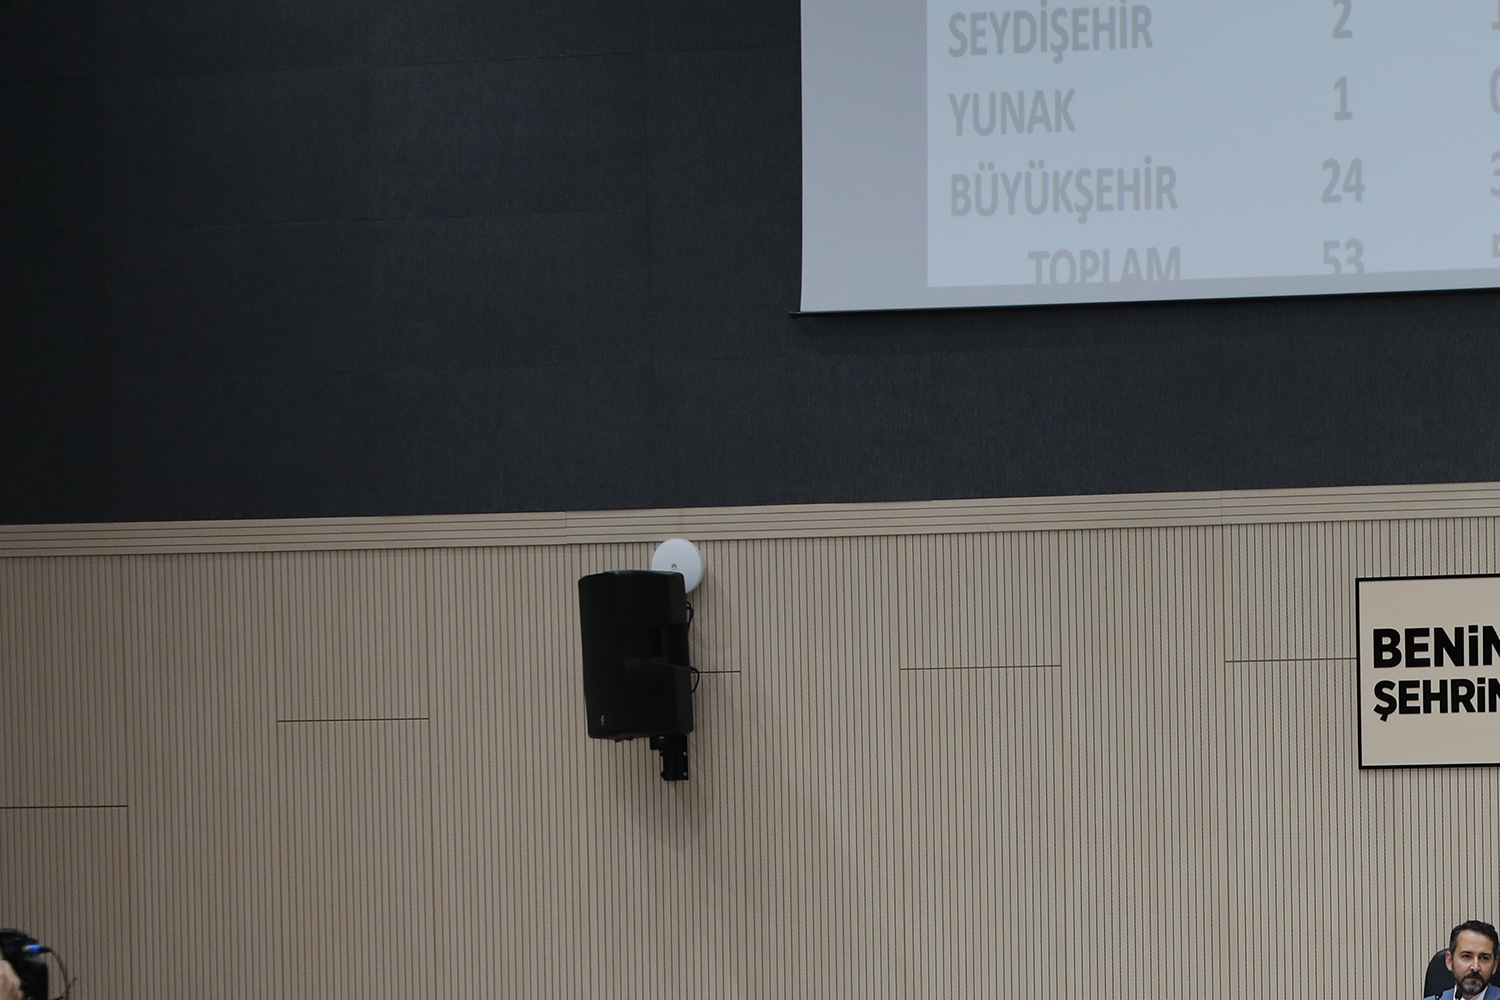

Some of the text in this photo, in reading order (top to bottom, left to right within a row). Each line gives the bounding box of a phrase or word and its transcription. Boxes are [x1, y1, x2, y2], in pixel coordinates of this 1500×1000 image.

[948, 0, 1154, 64] SEYDİŞEHİR
[1332, 0, 1354, 40] 2
[948, 87, 1077, 137] YUNAK
[1333, 76, 1354, 121] 1
[951, 154, 1179, 224] BÜYÜKŞEHİR
[1321, 157, 1366, 203] 24
[1323, 238, 1366, 275] 53
